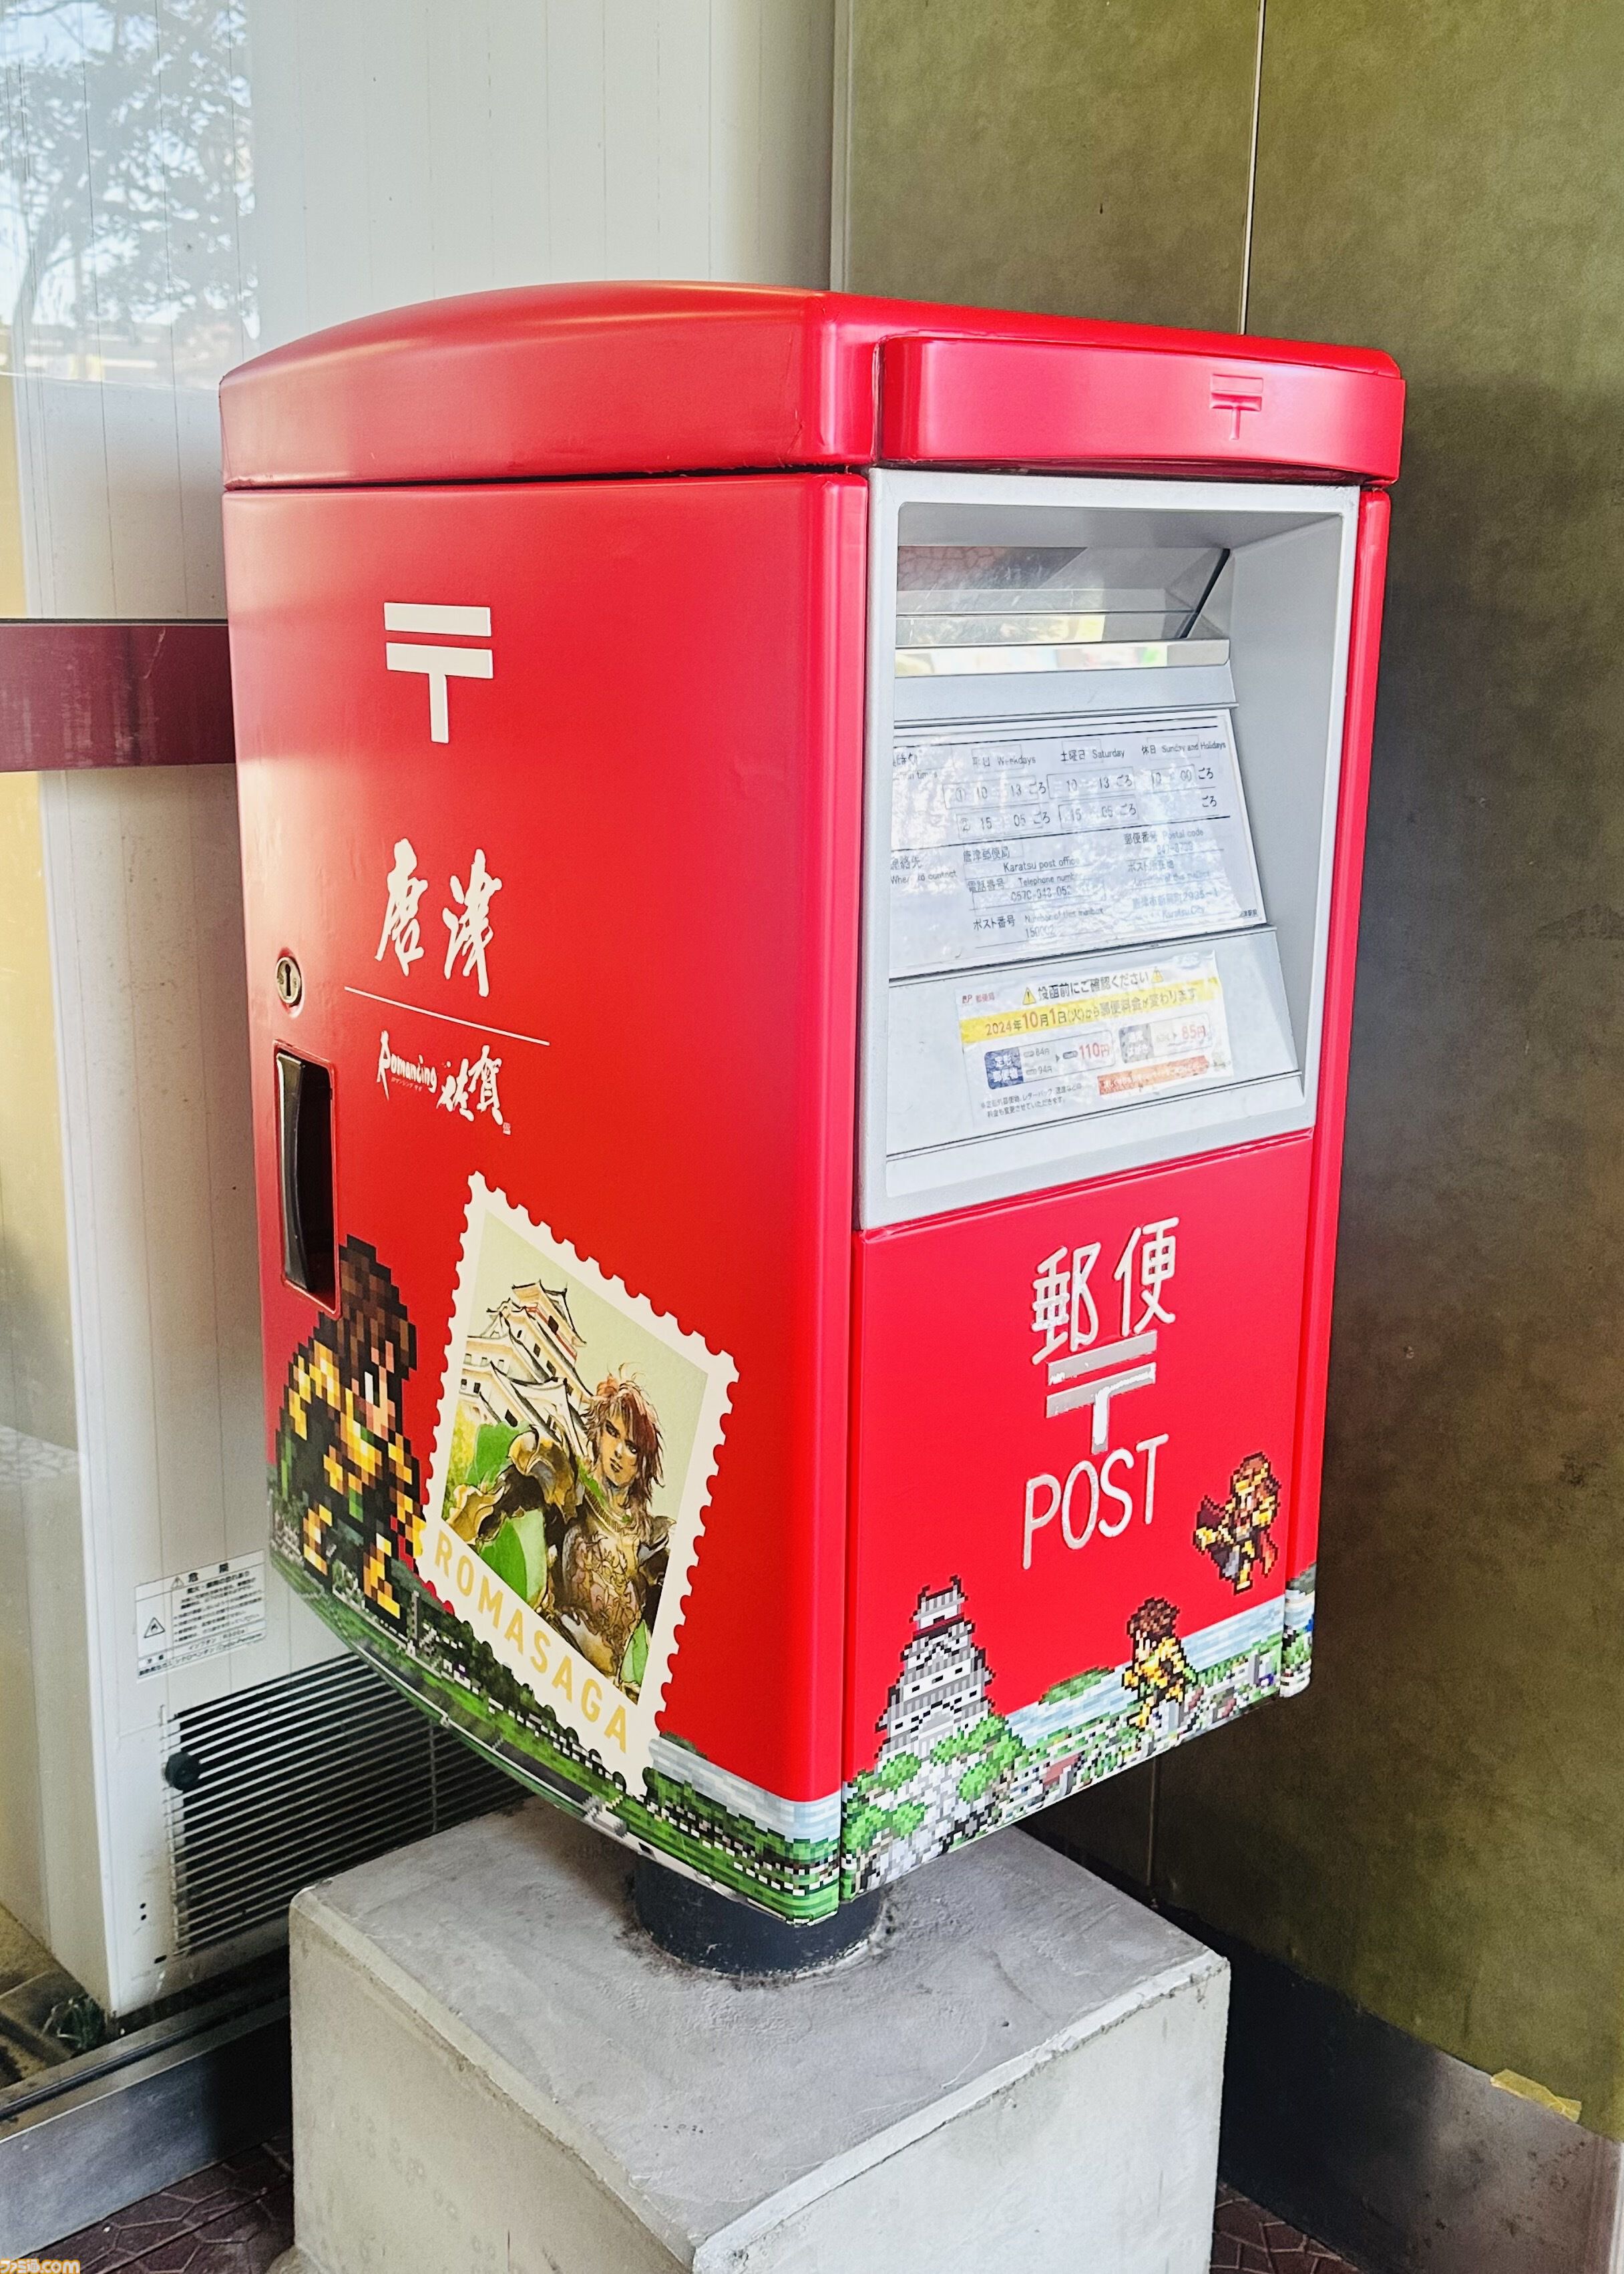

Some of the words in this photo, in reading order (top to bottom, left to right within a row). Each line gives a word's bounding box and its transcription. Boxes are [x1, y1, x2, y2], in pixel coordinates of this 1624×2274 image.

[998, 753, 1036, 767] Weekdays
[1092, 748, 1125, 759] Saturday
[1202, 795, 1217, 807] ごろ
[1187, 827, 1204, 838] code
[1003, 862, 1037, 874] Karatsu
[1039, 859, 1056, 871] post
[1018, 876, 1054, 888] Telephone
[973, 914, 1016, 931] ポスト番号
[1037, 971, 1149, 1001] 投函前にご確認ください
[1079, 1042, 1110, 1061] 110円
[1031, 1216, 1180, 1365] 郵便
[1022, 1433, 1169, 1570] POST
[434, 1529, 628, 1754] ROMASAGA
